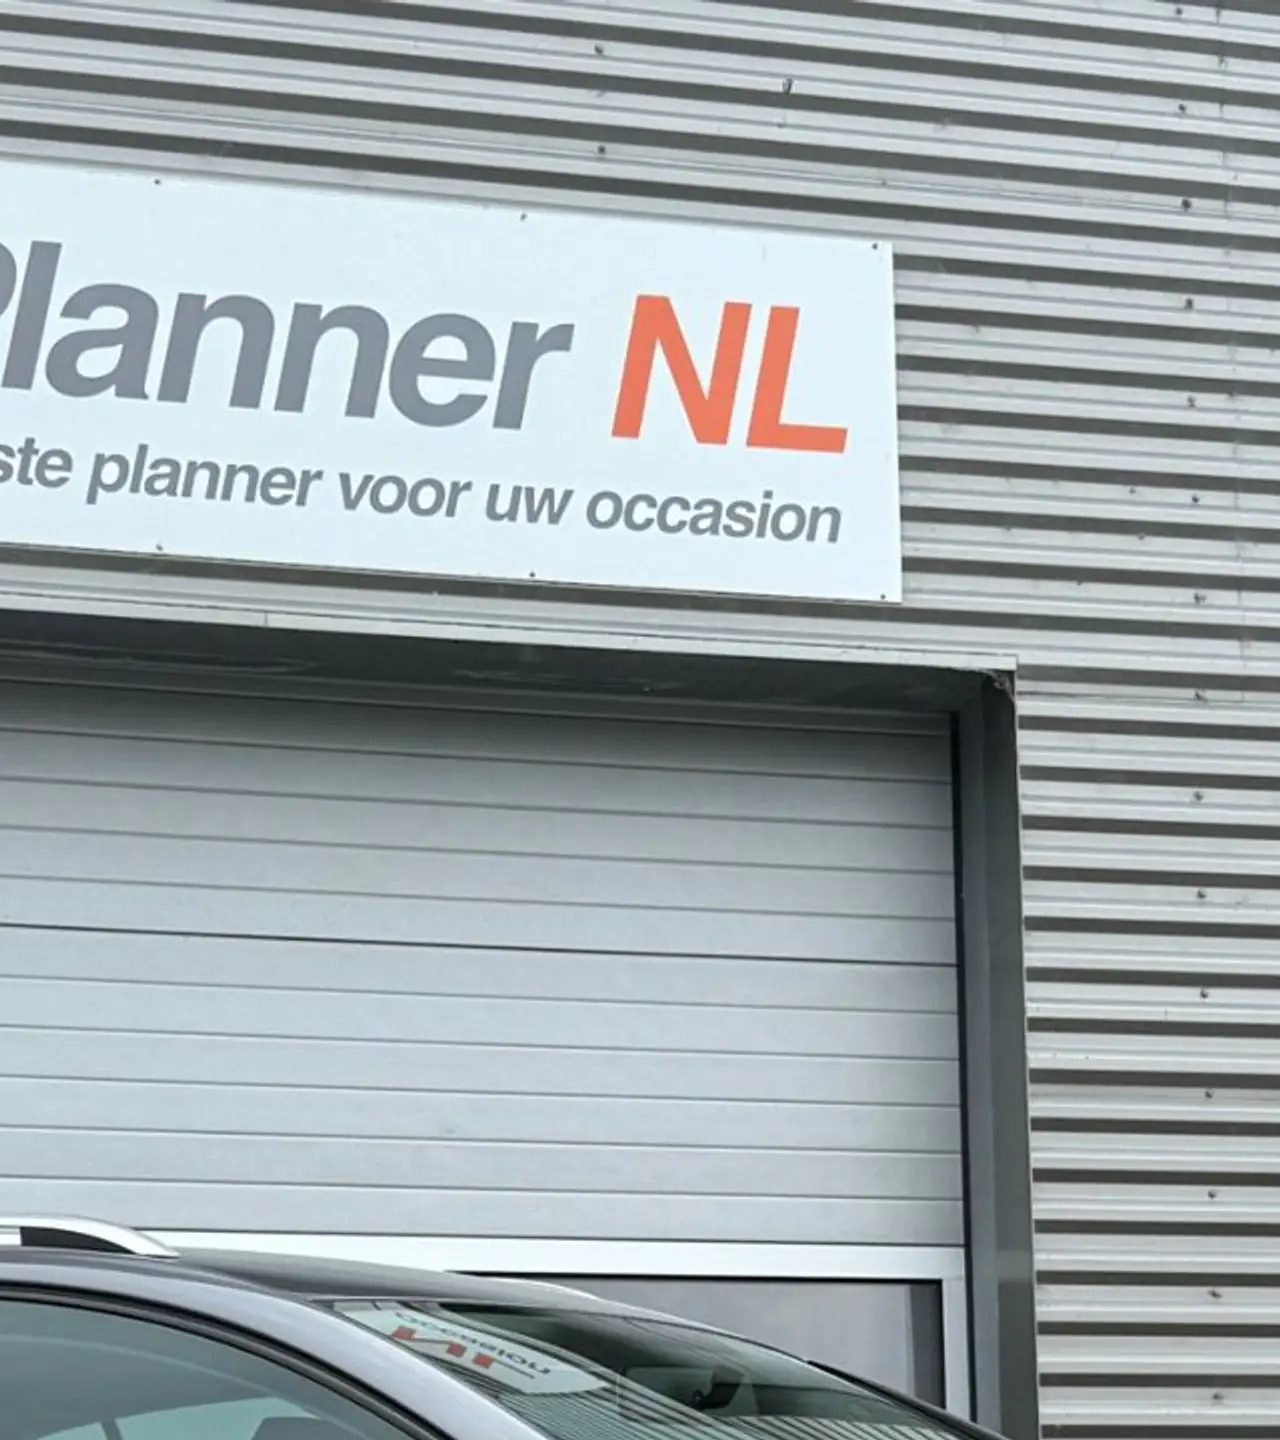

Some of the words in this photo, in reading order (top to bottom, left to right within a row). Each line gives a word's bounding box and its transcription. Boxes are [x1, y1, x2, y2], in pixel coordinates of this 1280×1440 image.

[614, 296, 846, 452] NL
[86, 444, 323, 507] planner
[339, 473, 472, 518] voor
[486, 484, 574, 524] uw
[587, 490, 841, 543] occasion
